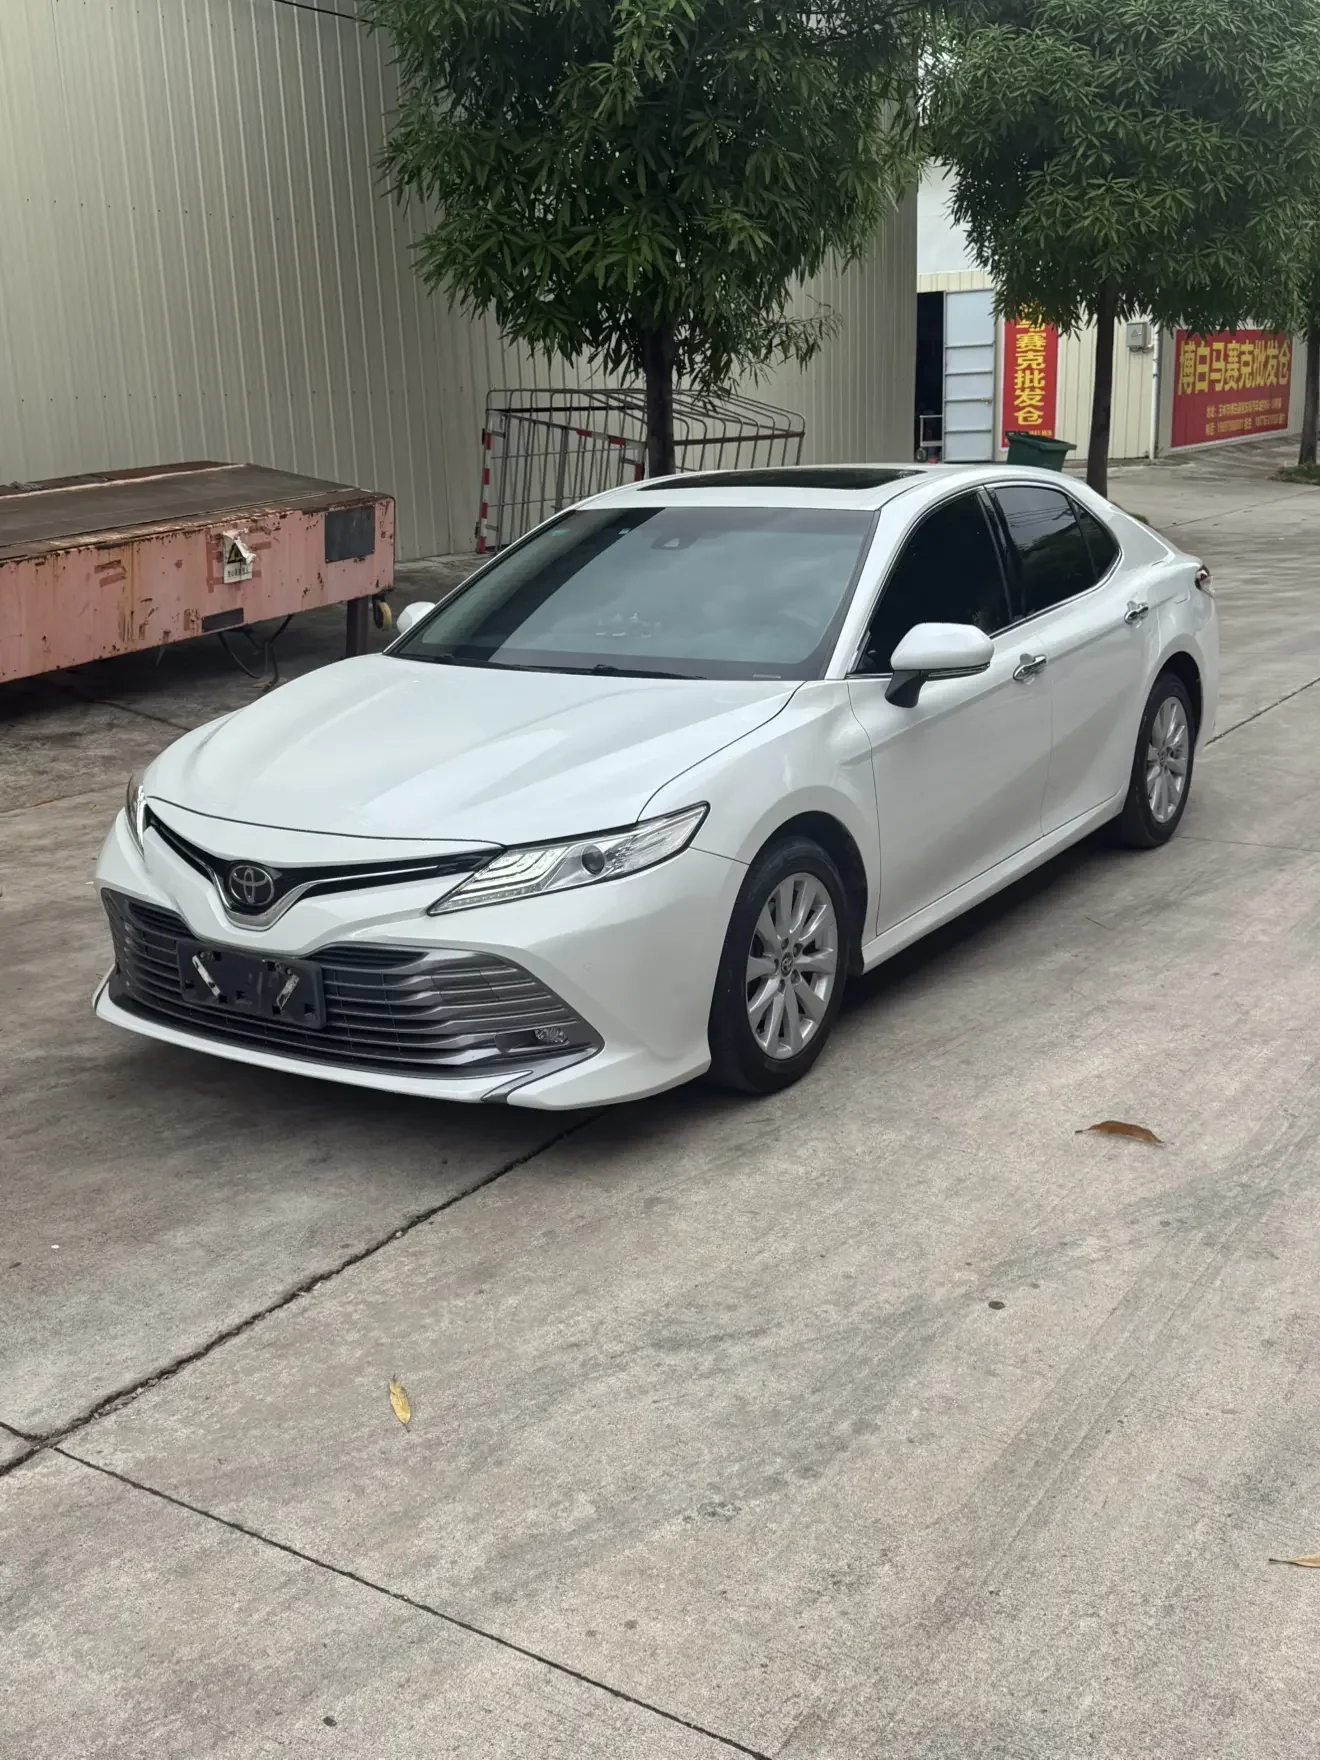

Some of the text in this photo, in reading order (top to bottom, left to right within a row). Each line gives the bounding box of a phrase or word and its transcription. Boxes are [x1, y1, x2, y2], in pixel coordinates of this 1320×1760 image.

[1178, 340, 1290, 395] 博白马赛克批发仓
